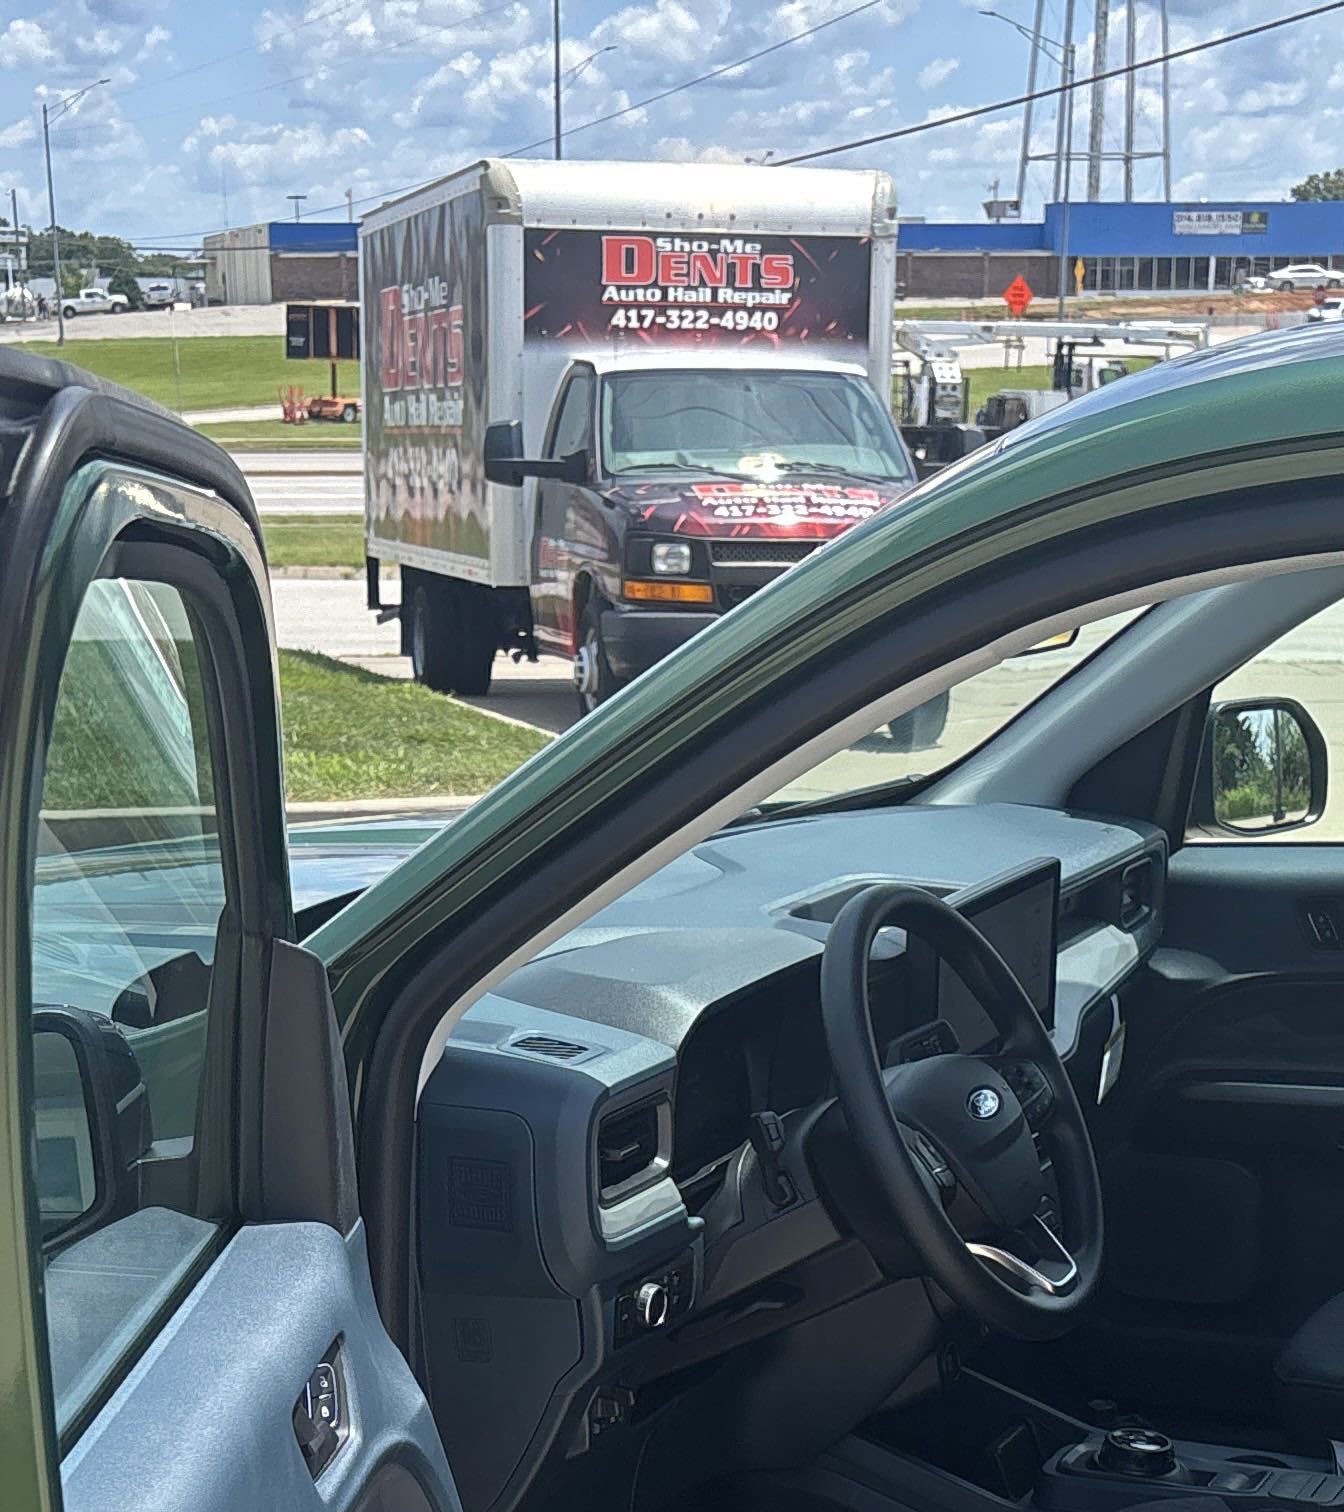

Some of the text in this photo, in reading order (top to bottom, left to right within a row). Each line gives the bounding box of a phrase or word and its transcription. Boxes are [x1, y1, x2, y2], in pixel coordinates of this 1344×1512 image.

[656, 237, 762, 254] Sho-Me
[601, 235, 795, 289] DENTS
[602, 286, 793, 307] Auto Hail Repair
[611, 308, 779, 331] 417-322-4940
[380, 285, 464, 392] DENTS
